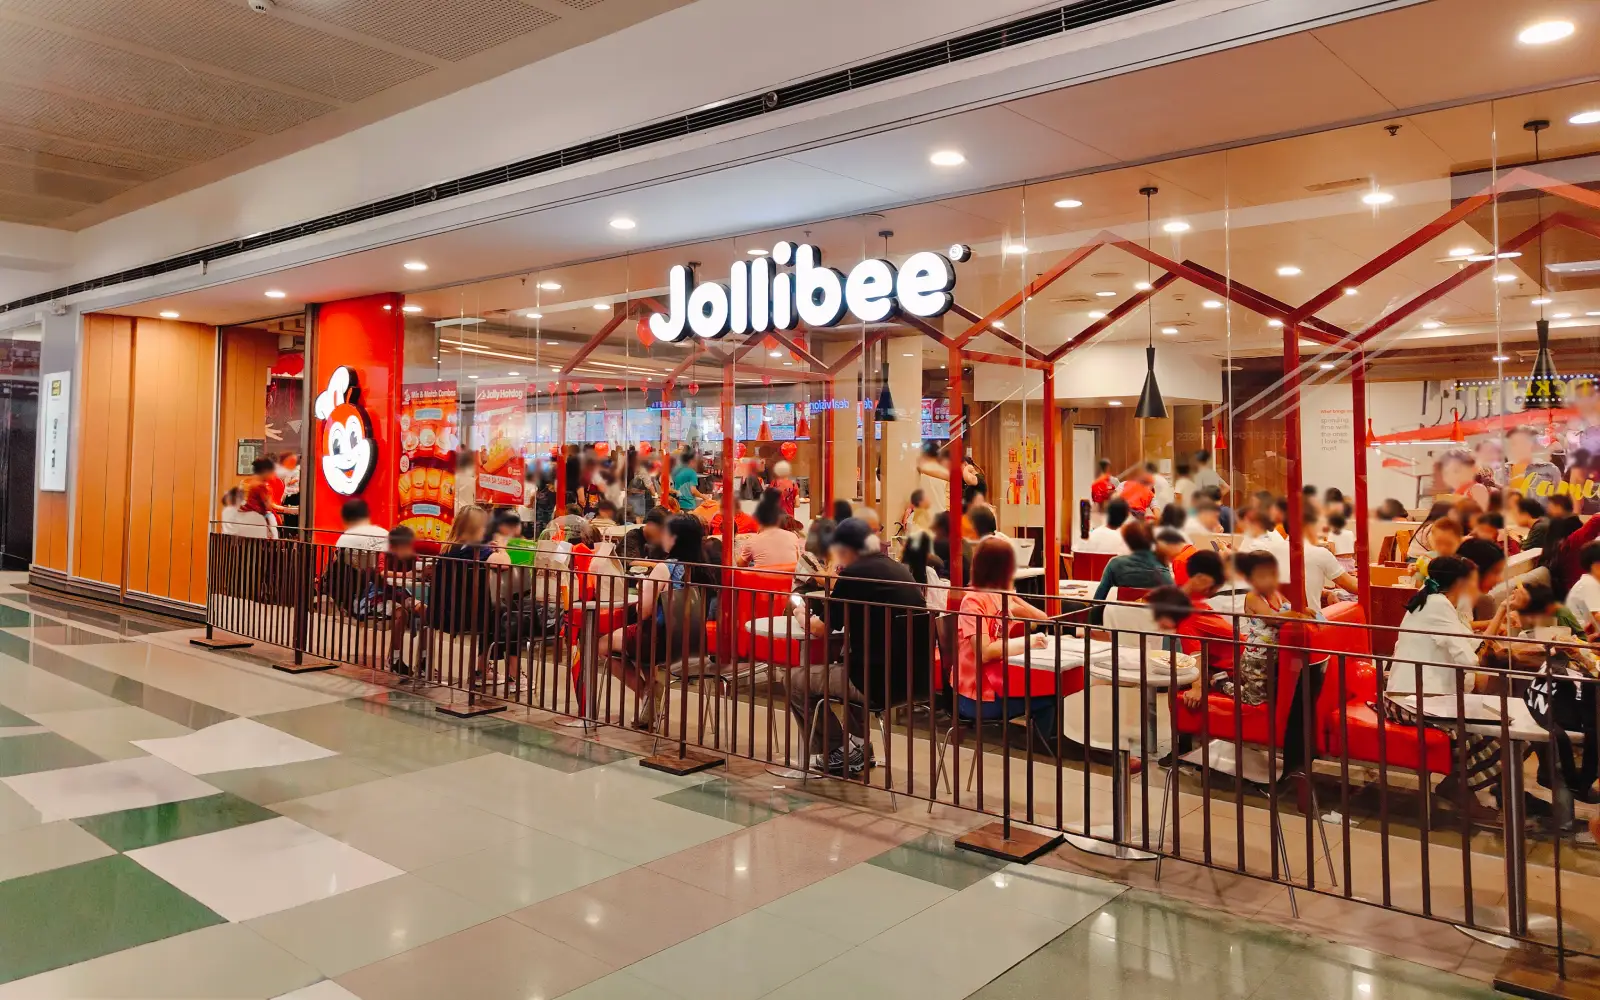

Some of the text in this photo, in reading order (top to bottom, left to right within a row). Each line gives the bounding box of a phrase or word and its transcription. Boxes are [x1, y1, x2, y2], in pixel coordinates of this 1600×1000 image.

[649, 241, 951, 342] Jollibee
[424, 389, 438, 398] Match
[438, 388, 456, 397] Combos
[486, 388, 523, 400] Jolly Hotdog
